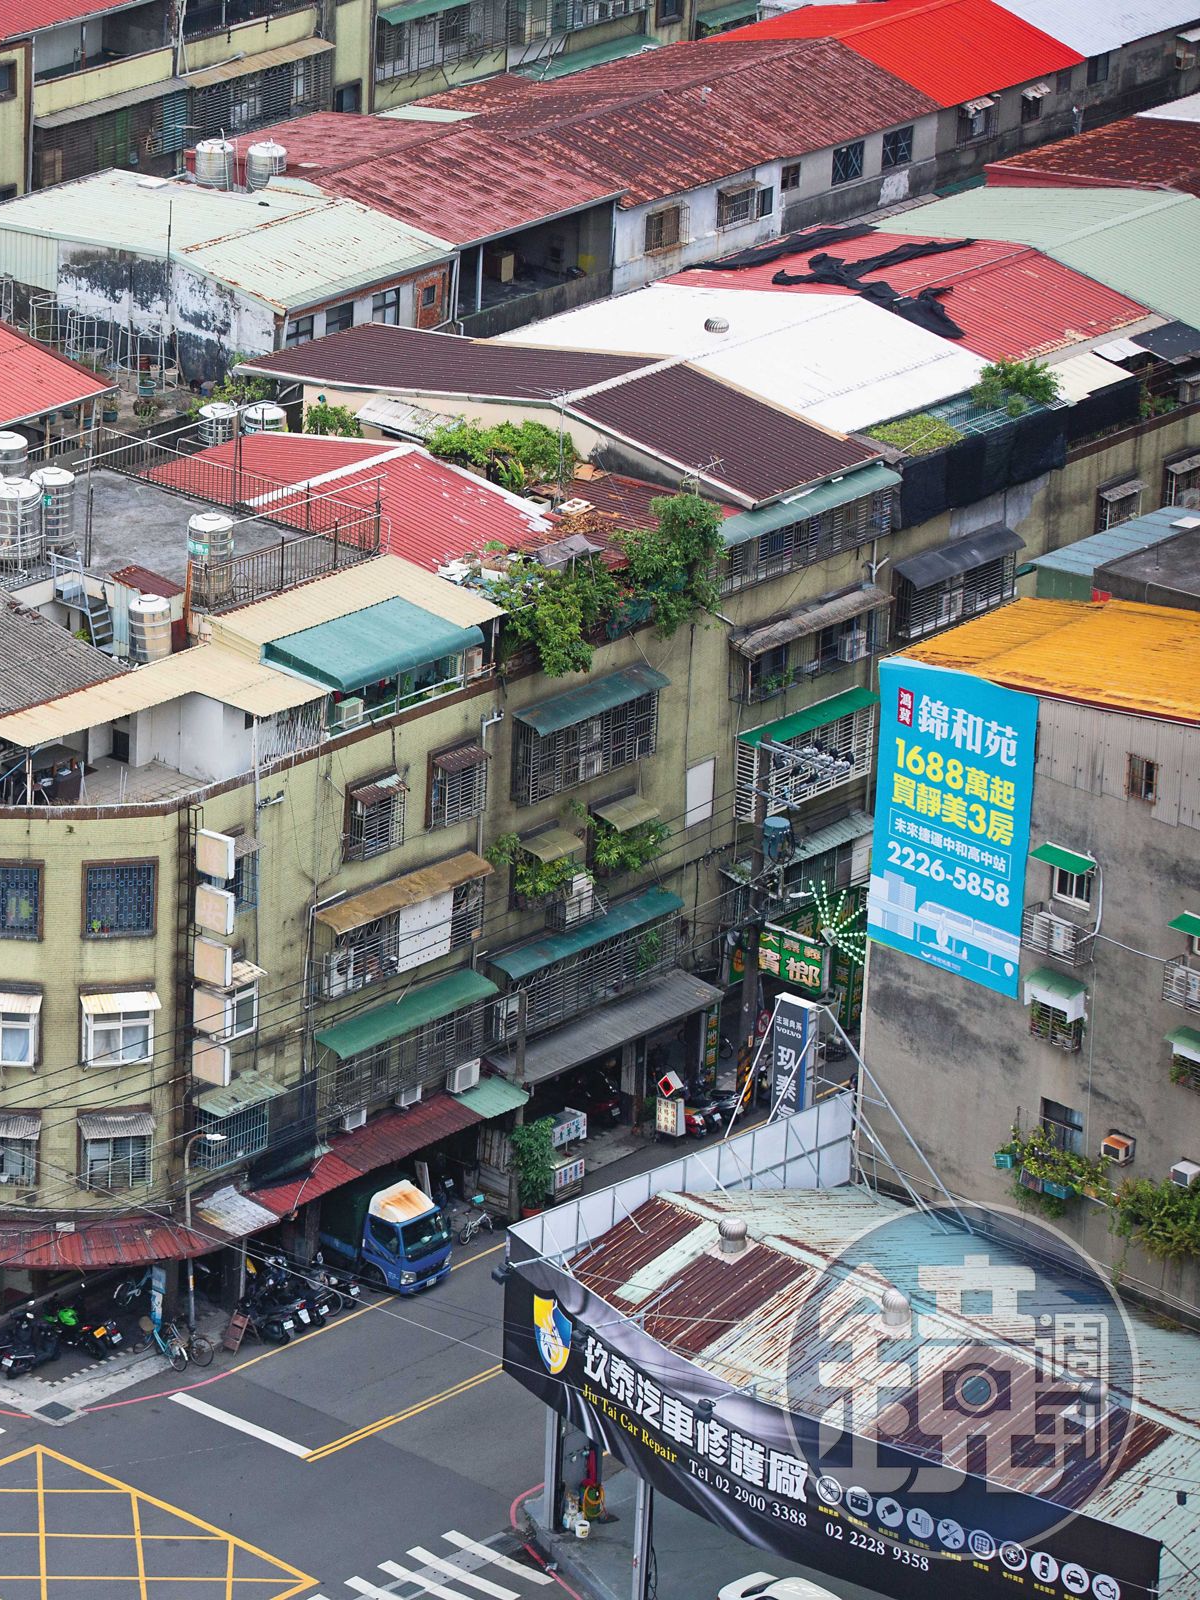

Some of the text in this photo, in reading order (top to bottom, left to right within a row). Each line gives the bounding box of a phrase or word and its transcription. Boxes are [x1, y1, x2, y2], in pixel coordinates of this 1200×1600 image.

[918, 694, 1018, 768] 錦和苑
[892, 772, 1014, 846] 買靜美3房
[895, 737, 1015, 811] 1688萬起
[887, 841, 1010, 908] 2226-5858
[894, 817, 1006, 873] 未來捷運中和高中站
[776, 1025, 802, 1039] VOLVO
[582, 1384, 678, 1464] Jiu Tai Car Repair
[583, 1335, 809, 1503] 玖泰汽車修護廠
[734, 1485, 766, 1512] 2900
[771, 1502, 807, 1527] 3388
[825, 1522, 843, 1540] 02
[849, 1531, 886, 1556] 2228
[892, 1546, 930, 1572] 9358
